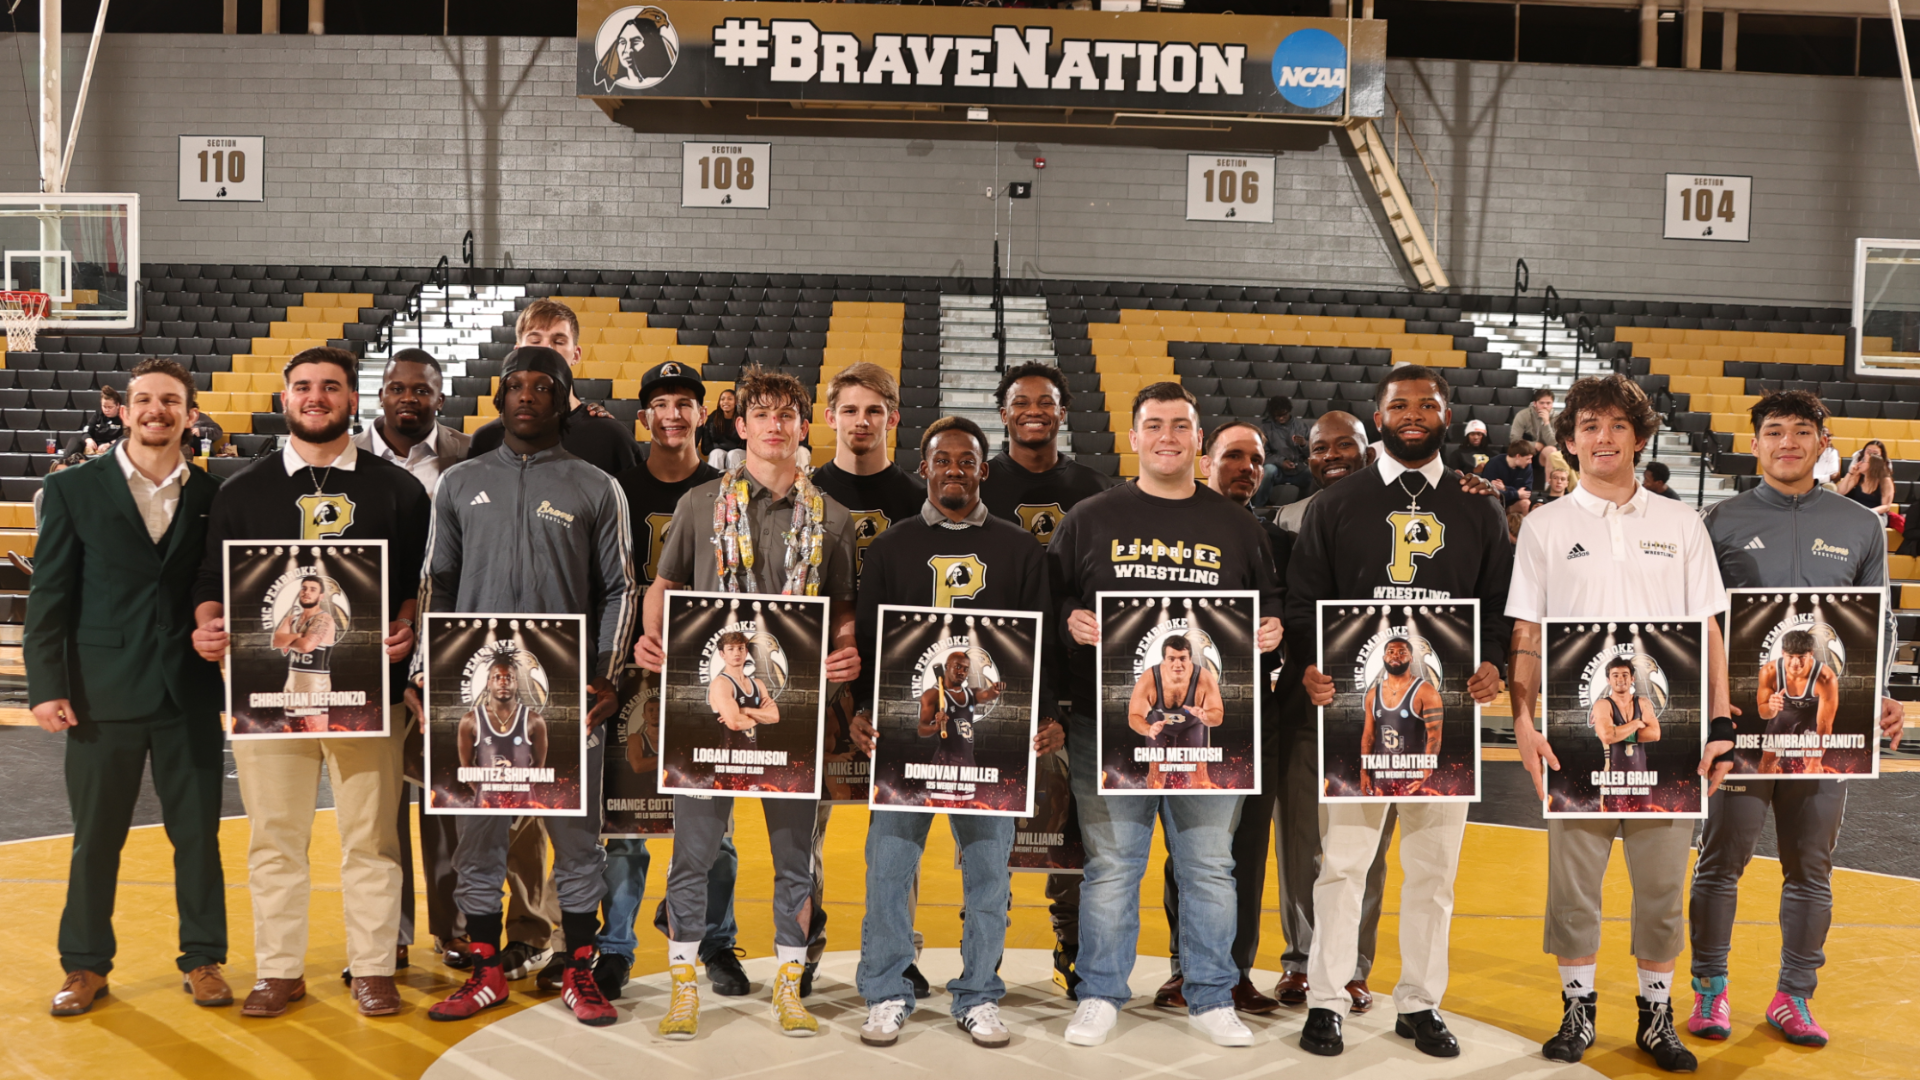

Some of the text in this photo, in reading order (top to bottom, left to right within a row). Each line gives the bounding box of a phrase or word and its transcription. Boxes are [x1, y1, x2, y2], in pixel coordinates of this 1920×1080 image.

[1278, 66, 1346, 88] NCAA
[207, 139, 237, 147] SECTION
[711, 146, 742, 154] SECTION
[198, 150, 245, 183] 110
[1216, 159, 1247, 167] SECTION
[698, 156, 755, 190] 108
[1203, 169, 1259, 204] 106
[1694, 177, 1724, 186] SECTION
[1680, 188, 1735, 222] 104
[1116, 544, 1217, 563] PEMBROKE
[1386, 511, 1445, 585] P
[1566, 550, 1590, 560] adidas
[1643, 550, 1674, 558] WRESTLING
[1113, 564, 1220, 586] WRESTLING
[261, 566, 317, 630] UNC PEMBROKE
[1373, 586, 1451, 600] WRESTLING
[1136, 617, 1188, 656] PEMBROKE
[1761, 612, 1815, 650] PEMBROKE
[1354, 626, 1408, 690] UNC PEMBROKE
[698, 660, 710, 683] UNC
[911, 635, 970, 698] UNC PEMBROKE
[1578, 643, 1634, 707] UNC PEMBROKE
[250, 691, 366, 708] CHRISTIAN DEFRONZO
[460, 680, 472, 703] UNC
[617, 687, 660, 743] UNC PEMBROK
[1735, 734, 1865, 749] JOSE ZAMBRANO CANUTO
[693, 747, 787, 766] LOGAN ROBINSON
[1134, 747, 1223, 762] CHAD METIKOSH
[1361, 754, 1438, 769] TKAII GAITHER
[457, 767, 555, 783] QUINTEZ SHIPMAN
[725, 765, 746, 774] WEIGHT
[747, 766, 764, 775] CLASS
[827, 762, 853, 776] MIKE
[904, 763, 999, 783] DONOVAN MILLER
[1159, 763, 1197, 772] HEAVYWEIGHT
[1385, 771, 1405, 779] WEIGHT
[1406, 771, 1424, 779] CLASS
[1591, 771, 1658, 786] CALEB GRAU
[936, 782, 957, 791] WEIGHT
[957, 783, 976, 792] CLASS
[1610, 787, 1631, 795] WEIGHT
[1632, 787, 1650, 795] CLASS
[607, 798, 673, 811] CHANCE COTT
[1017, 832, 1064, 846] WILLIAMS
